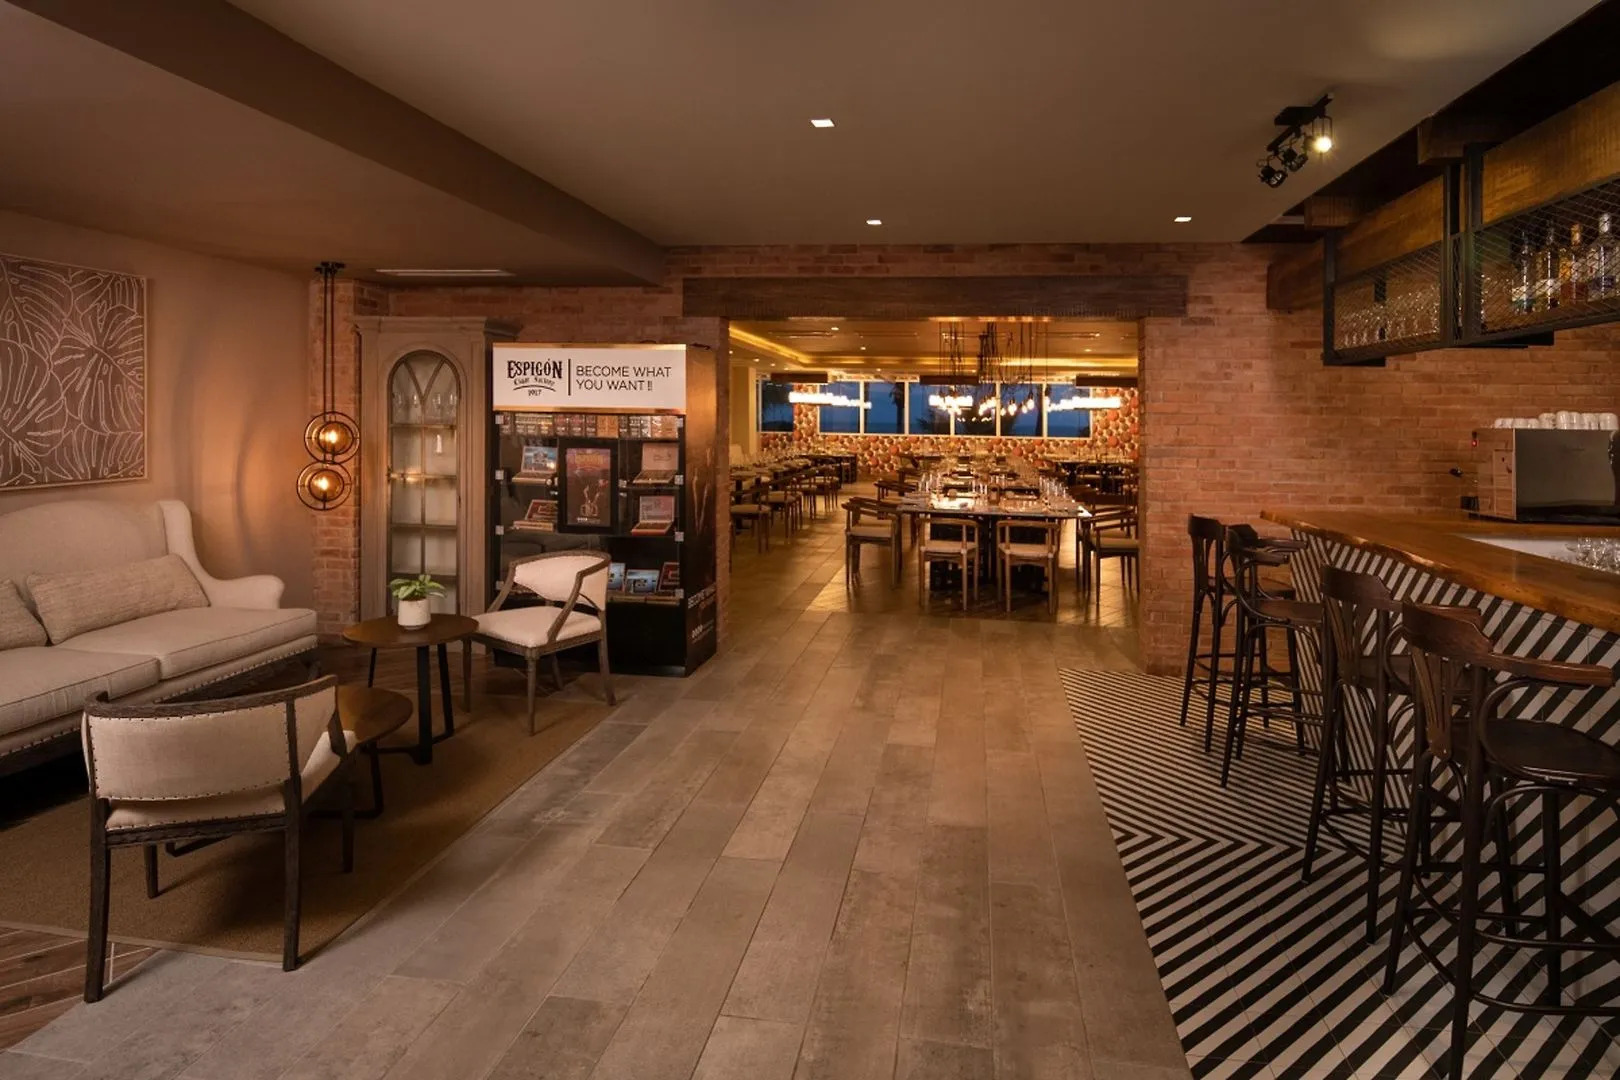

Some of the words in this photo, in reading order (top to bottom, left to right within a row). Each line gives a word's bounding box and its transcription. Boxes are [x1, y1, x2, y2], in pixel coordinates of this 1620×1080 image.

[507, 358, 562, 379] ESPIGÓN
[576, 366, 629, 377] BECOME
[633, 366, 672, 377] WHAT
[576, 380, 603, 391] YOU
[607, 380, 644, 391] WANT
